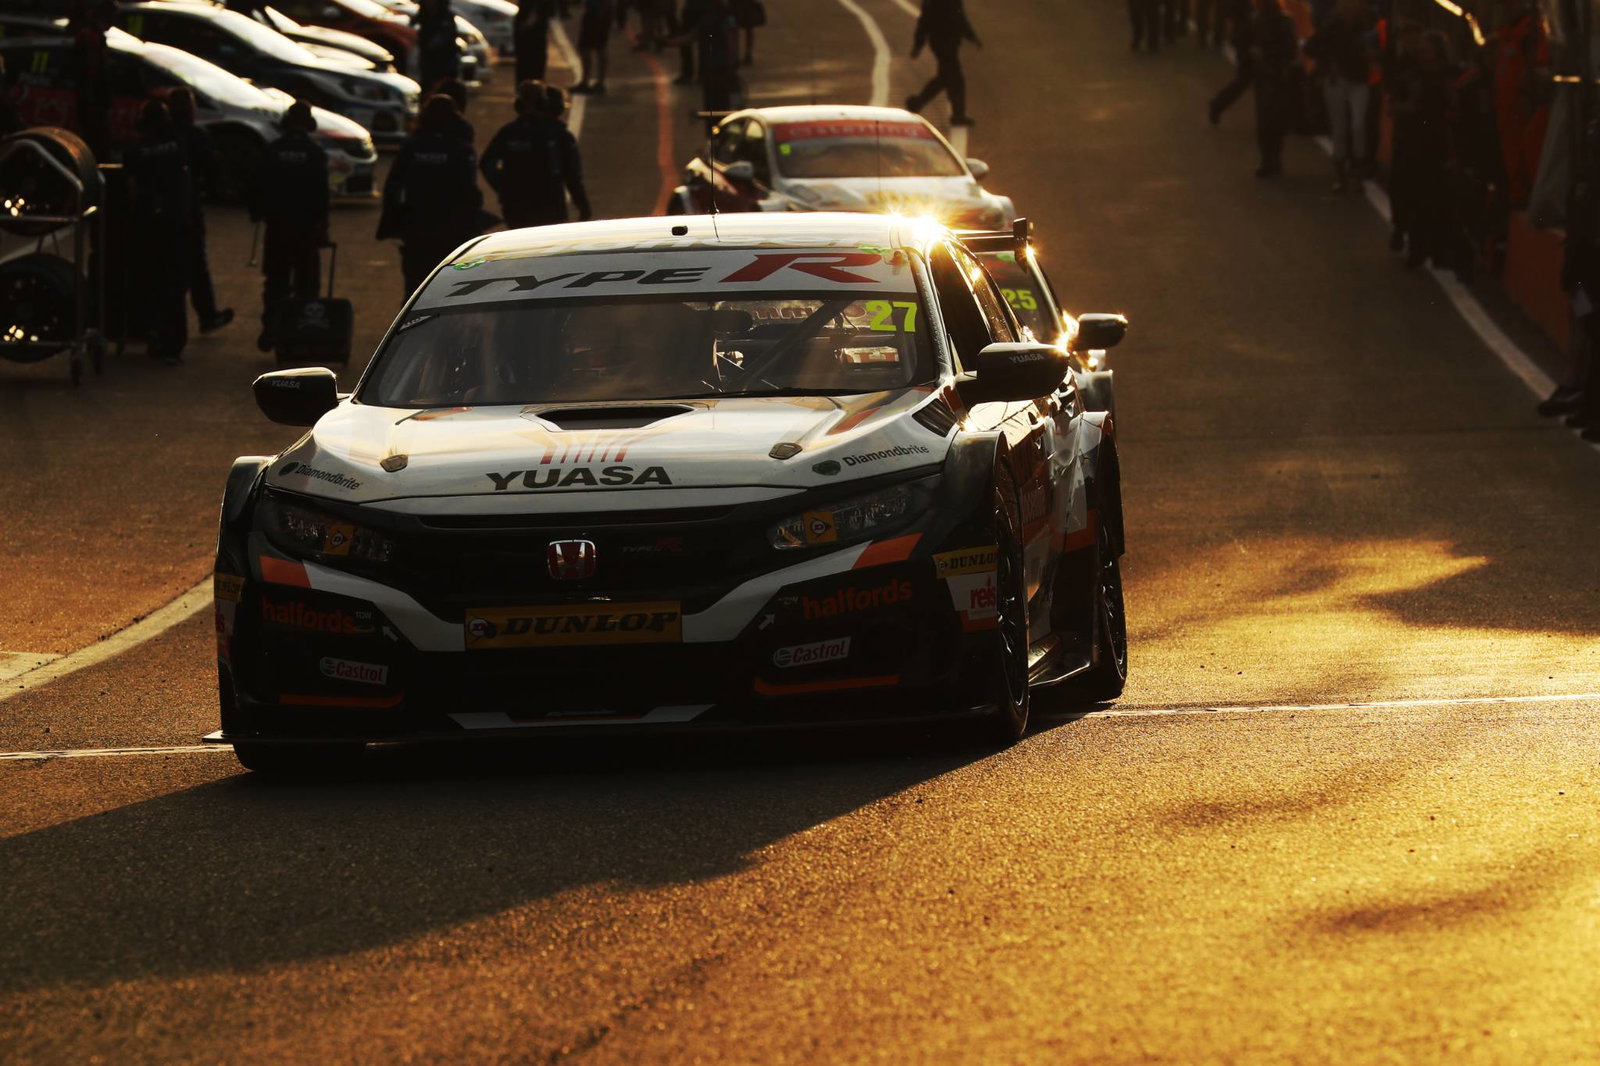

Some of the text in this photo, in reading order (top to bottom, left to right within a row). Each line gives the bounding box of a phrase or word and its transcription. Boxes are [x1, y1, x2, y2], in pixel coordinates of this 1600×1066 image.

[445, 252, 882, 297] TYPE R
[1001, 288, 1038, 310] 25
[865, 301, 918, 333] 27
[1008, 353, 1045, 364] YUASA
[271, 379, 300, 389] YUASA
[842, 444, 930, 466] Diamondbrite
[295, 463, 361, 490] Diamondbrite
[486, 466, 673, 490] YUASA
[951, 551, 997, 569] DUNLO
[802, 579, 912, 620] halfords
[261, 595, 354, 633] halfords
[502, 612, 678, 635] DUNLOP
[793, 640, 846, 663] Castrol
[335, 661, 384, 682] Castrol
